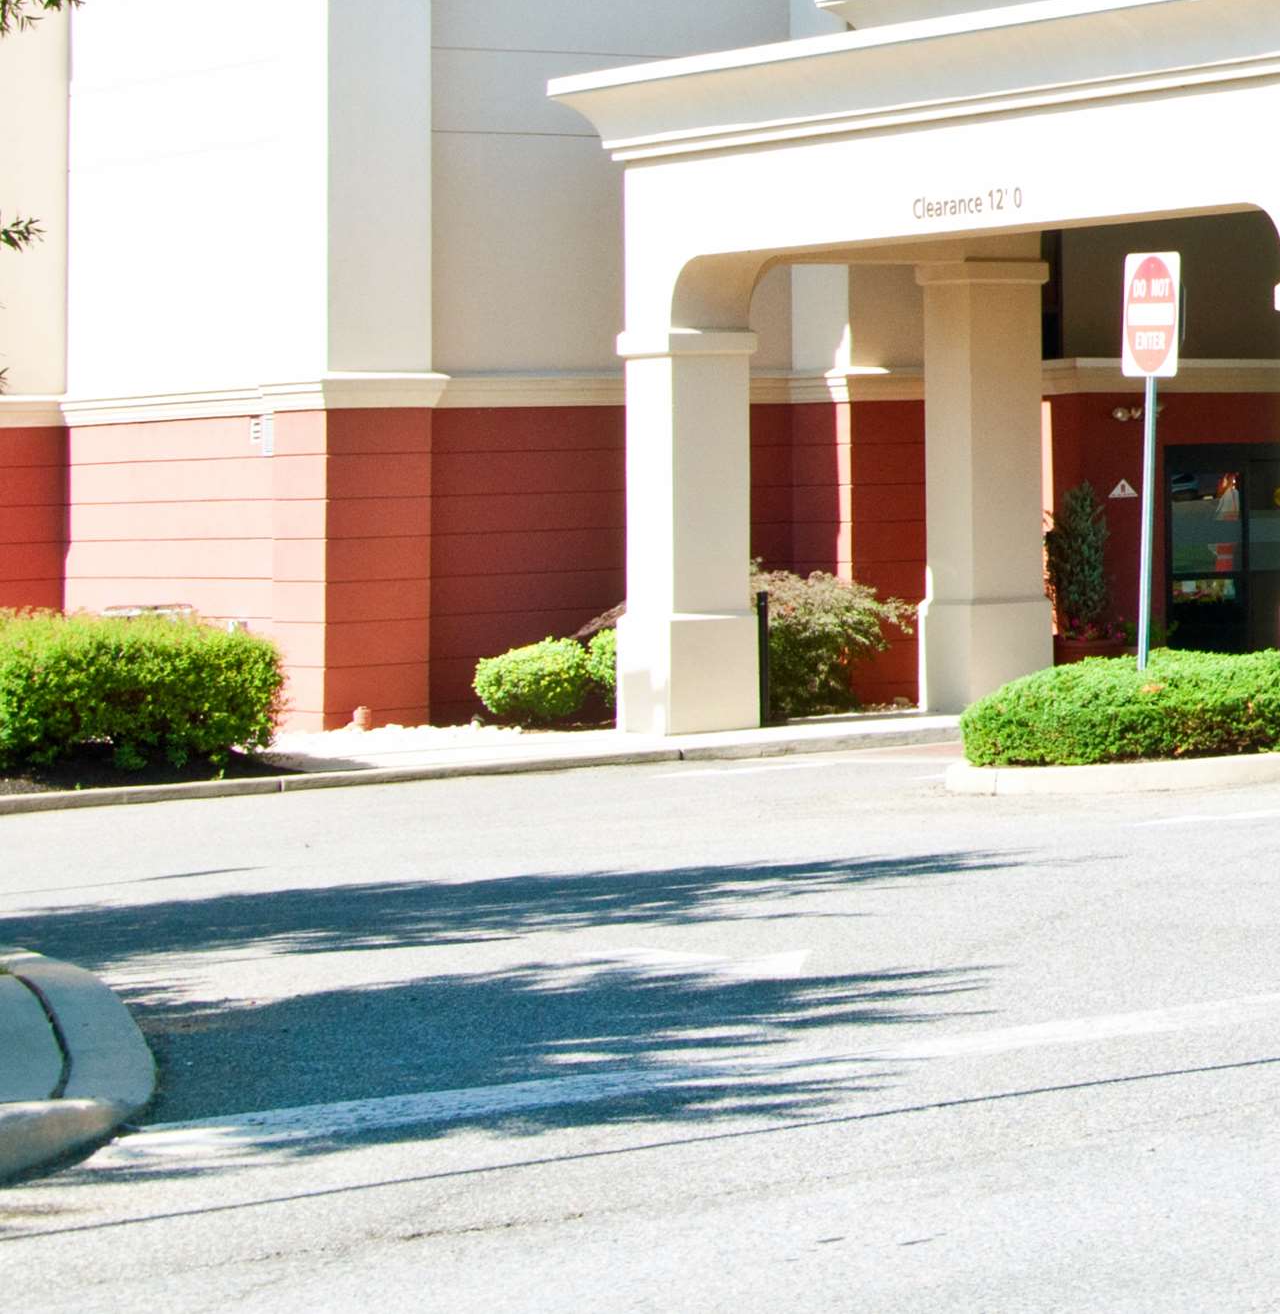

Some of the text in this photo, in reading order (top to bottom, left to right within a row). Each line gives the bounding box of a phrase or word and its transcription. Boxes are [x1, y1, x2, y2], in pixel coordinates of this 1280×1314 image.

[912, 196, 983, 219] Clearance
[1133, 278, 1170, 298] DO NOT
[1135, 332, 1166, 350] ENTER
